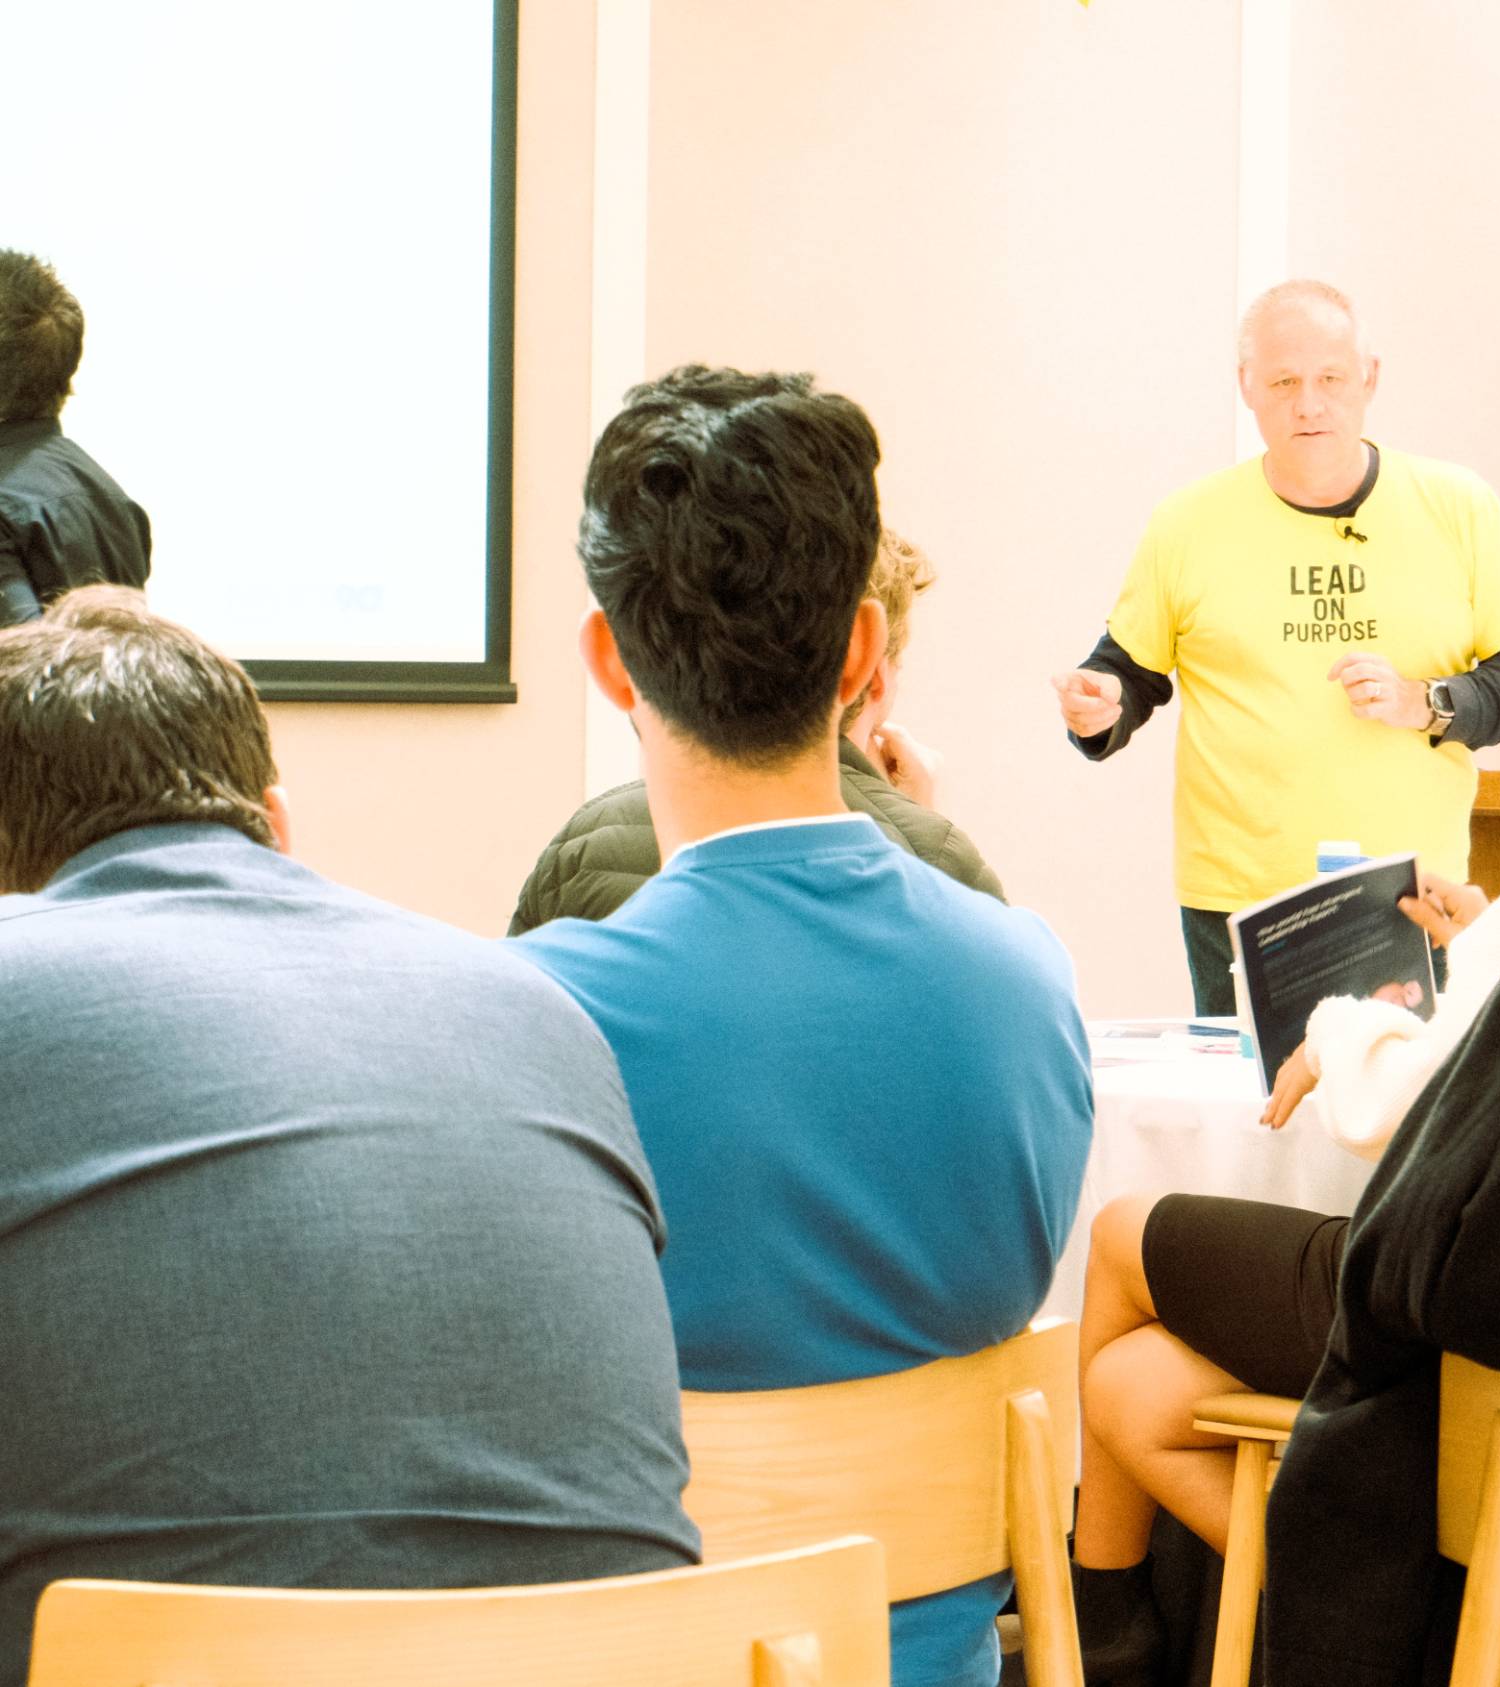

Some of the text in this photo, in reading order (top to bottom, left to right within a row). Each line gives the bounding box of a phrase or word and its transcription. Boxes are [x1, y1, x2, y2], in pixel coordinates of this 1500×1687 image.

[1290, 564, 1366, 595] LEAD
[1313, 598, 1345, 621] ON
[1283, 619, 1378, 643] PURPOSE
